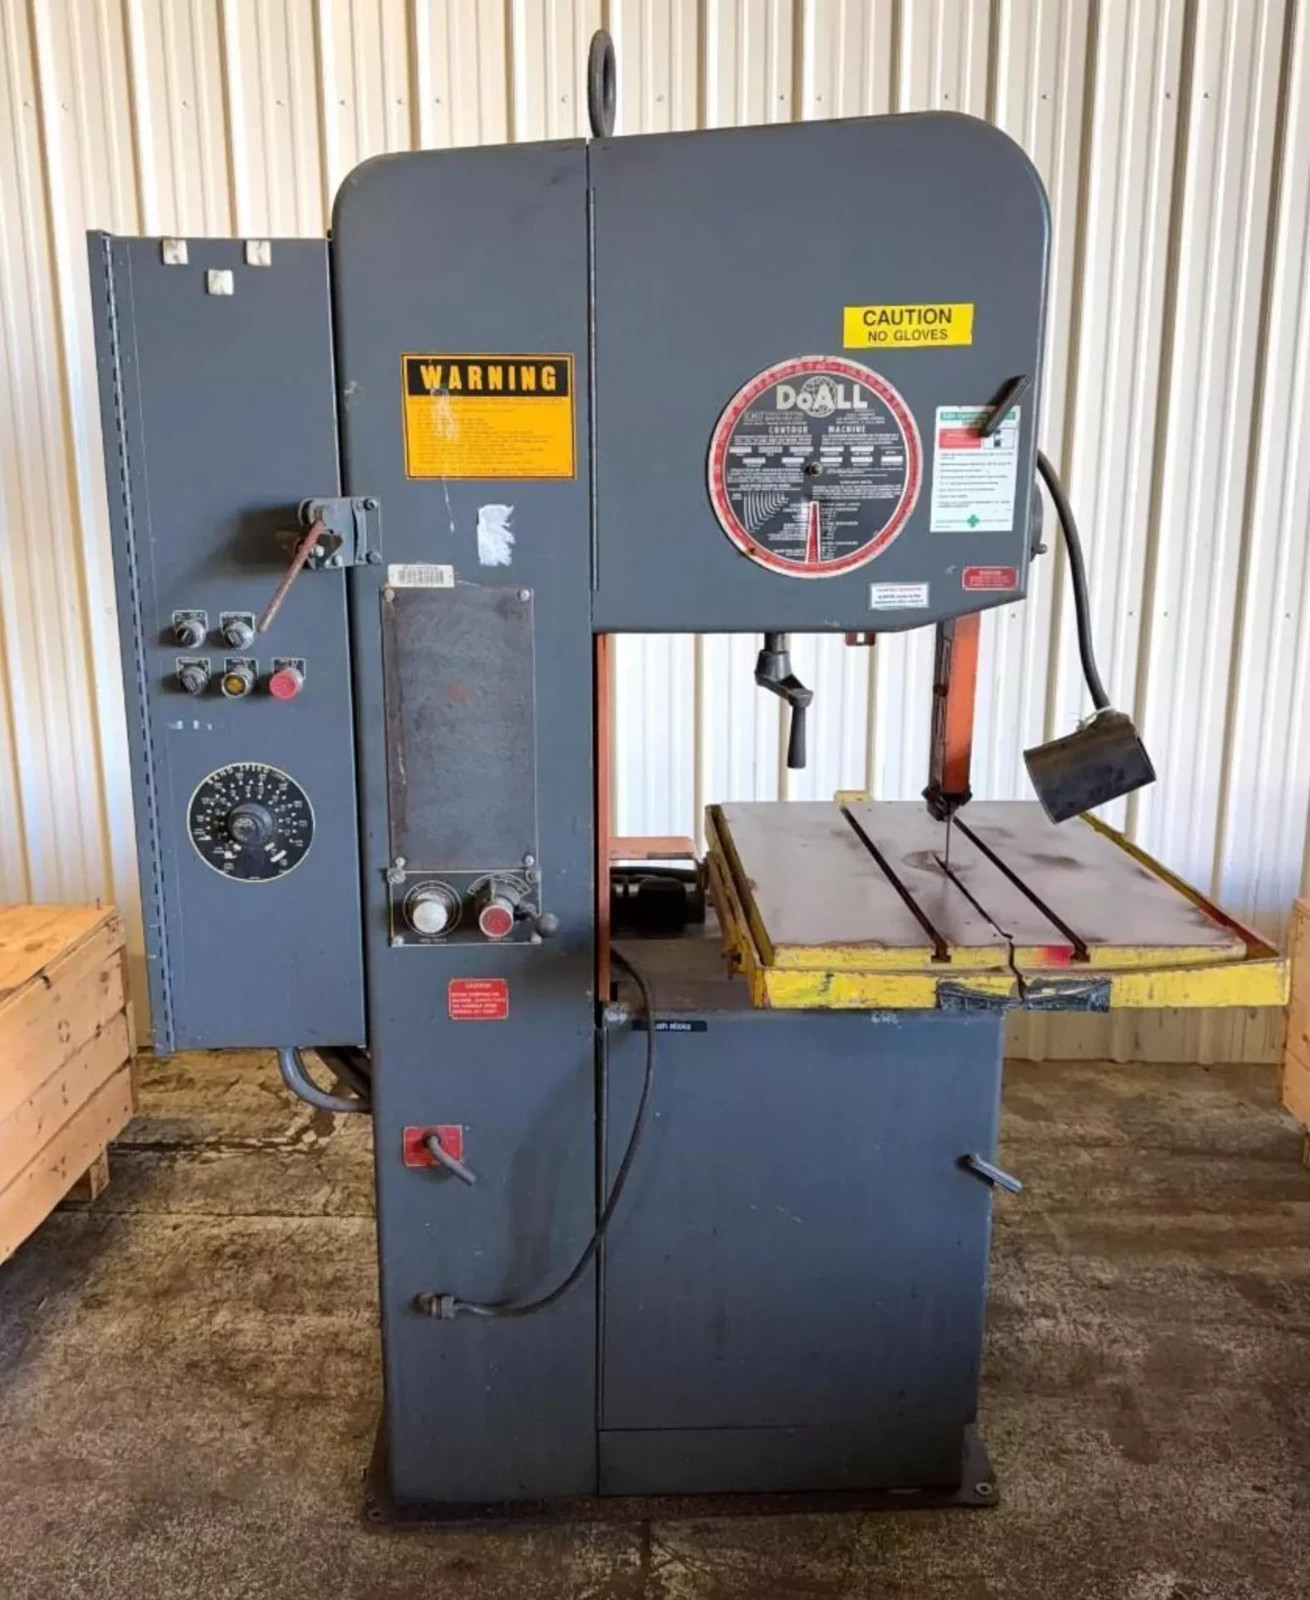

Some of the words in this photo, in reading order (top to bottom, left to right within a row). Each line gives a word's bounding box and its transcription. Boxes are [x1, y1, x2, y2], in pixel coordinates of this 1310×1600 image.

[862, 307, 953, 327] CAUTION
[867, 330, 888, 343] NO
[893, 328, 948, 342] GLOVES
[419, 364, 557, 391] WARNING
[776, 384, 869, 410] DoALL
[768, 425, 809, 434] CONTOUR
[827, 424, 866, 434] MACHINE
